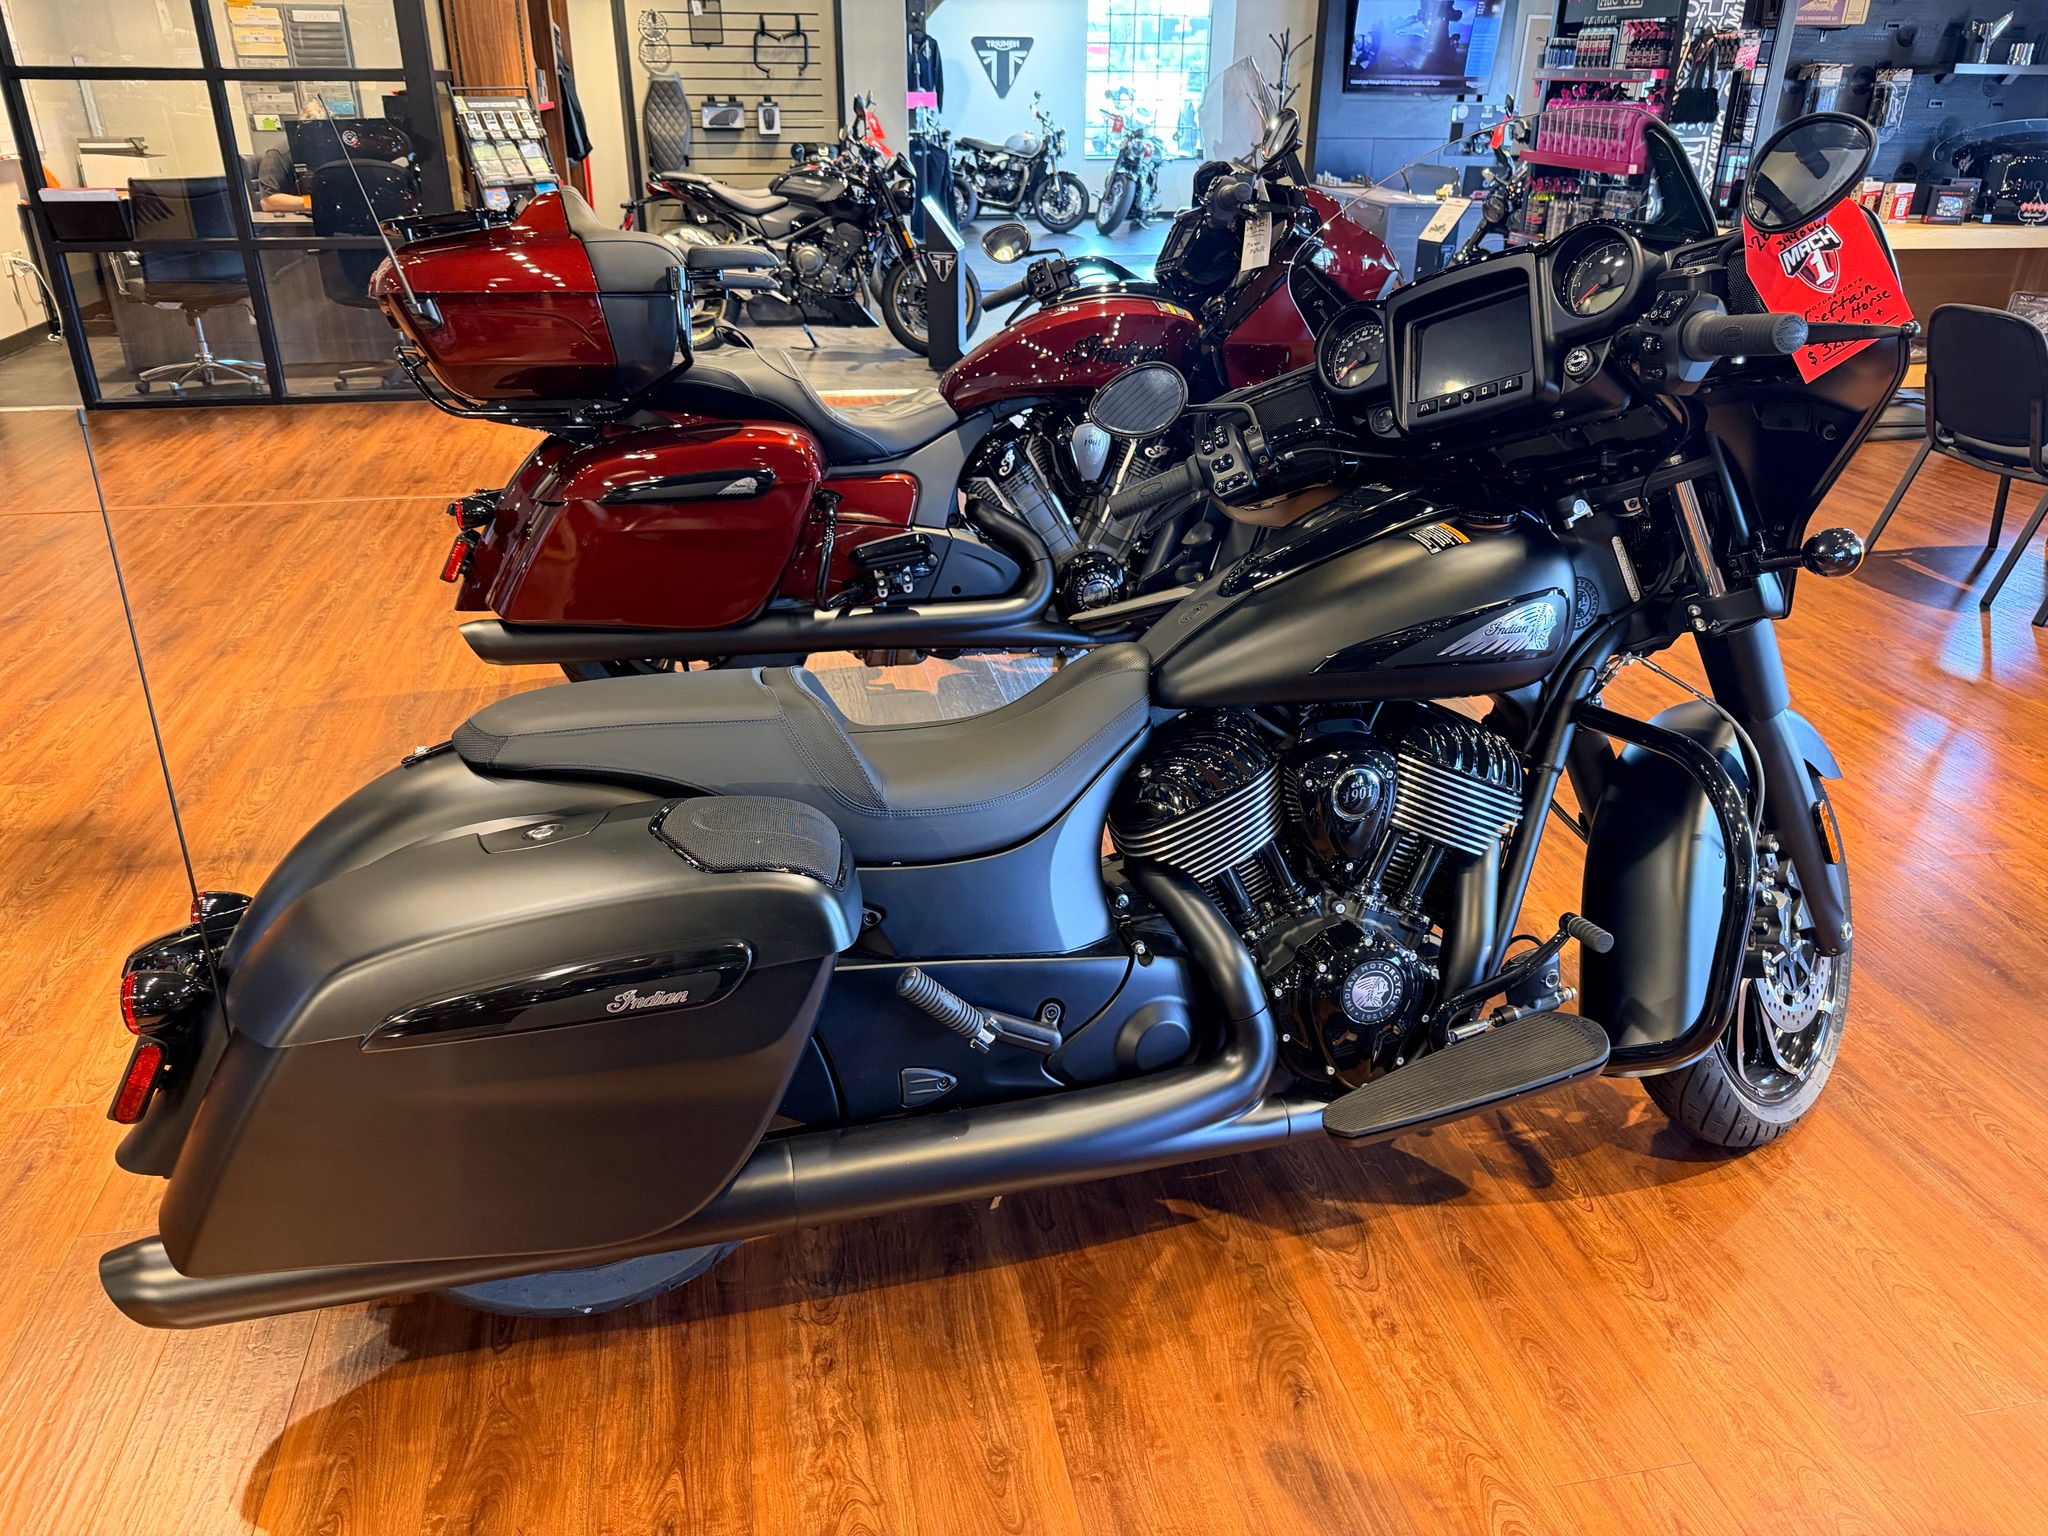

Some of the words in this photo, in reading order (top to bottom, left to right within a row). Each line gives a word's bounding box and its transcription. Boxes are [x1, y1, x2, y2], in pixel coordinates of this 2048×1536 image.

[985, 40, 1020, 50] TRIUMPH
[1782, 226, 1840, 275] MACH
[1809, 249, 1835, 286] 1
[1807, 277, 1864, 314] MOTORSPORTS
[1852, 290, 1892, 318] Horse
[1484, 621, 1529, 636] Indian
[1343, 785, 1373, 804] 1901
[1344, 973, 1359, 1011] INDIAN
[1361, 963, 1402, 1007] MOTORCYCLE
[606, 989, 689, 1013] Indian
[1361, 1012, 1383, 1020] 1901
